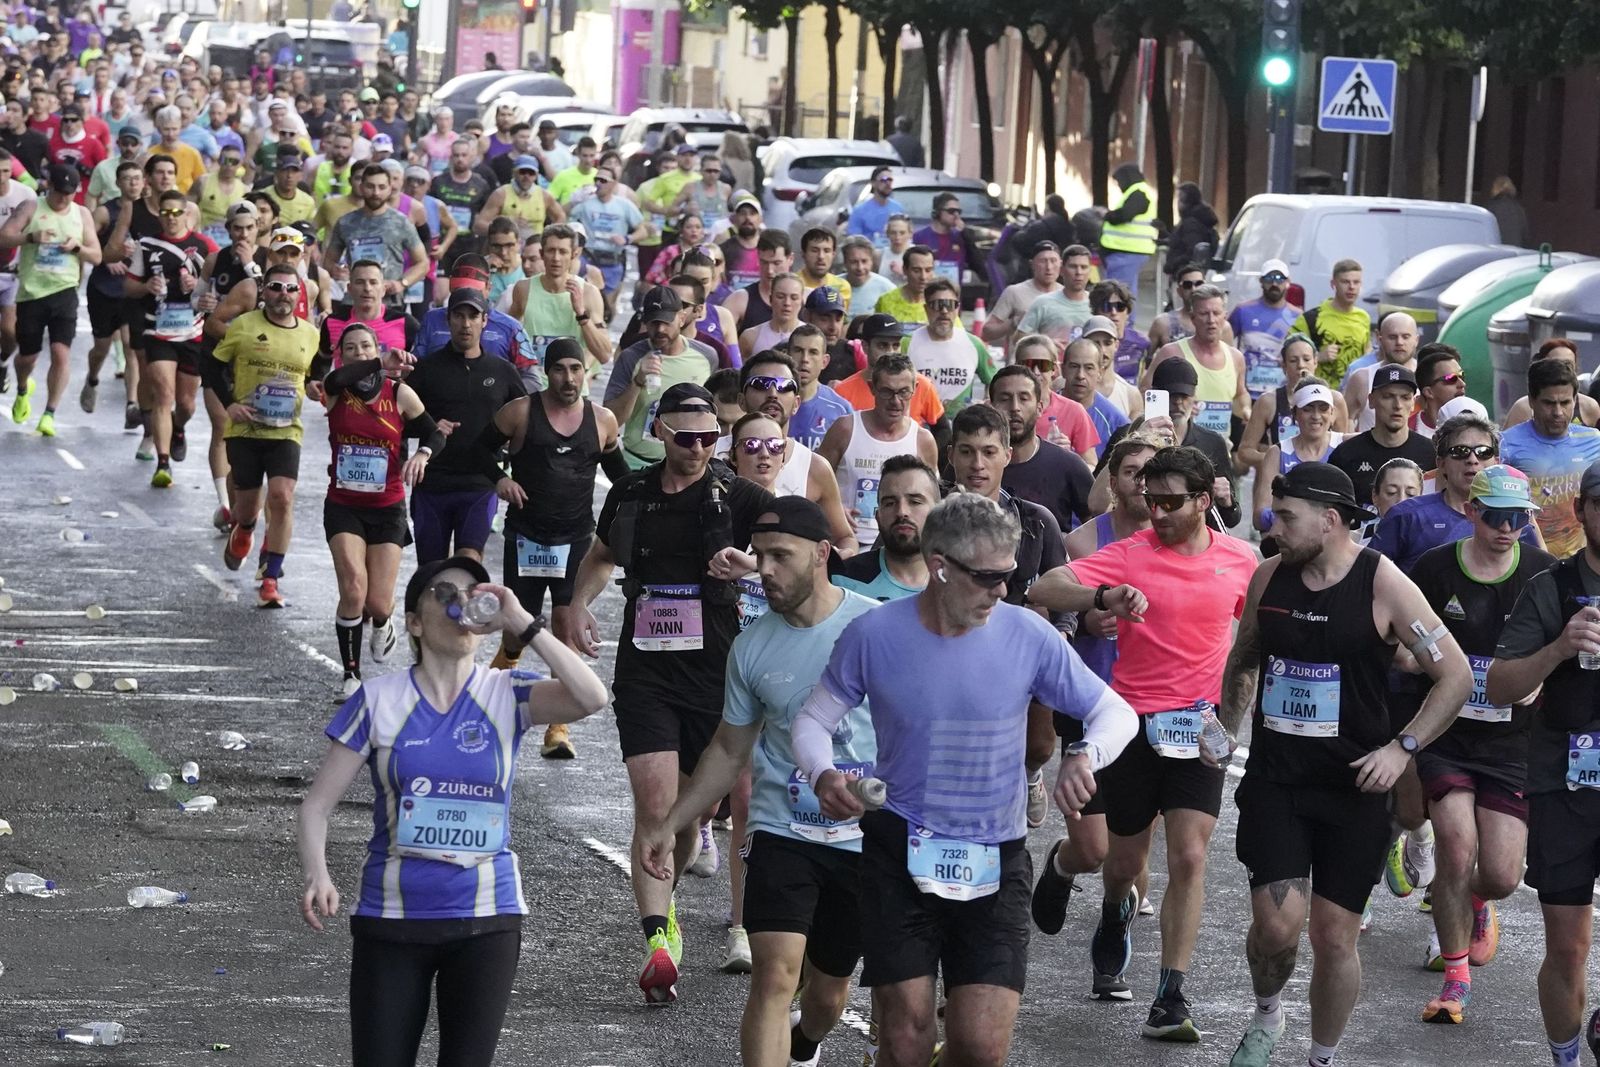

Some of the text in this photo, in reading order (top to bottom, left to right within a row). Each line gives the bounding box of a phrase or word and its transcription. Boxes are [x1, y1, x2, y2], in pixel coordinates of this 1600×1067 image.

[939, 378, 967, 386] HARO
[347, 470, 376, 482] SOFIA
[528, 554, 559, 566] EMILIO
[652, 607, 678, 618] 10883
[648, 620, 683, 635] YANN
[1289, 665, 1332, 678] ZURICH
[1289, 686, 1311, 699] 7274
[1281, 700, 1317, 719] LIAM
[1171, 716, 1193, 727] 8496
[1157, 728, 1201, 744] MICHE
[437, 782, 494, 798] ZURICH
[436, 808, 467, 823] 8780
[412, 825, 488, 848] ZOUZOU
[941, 848, 969, 860] 7328
[934, 863, 973, 882] RICO
